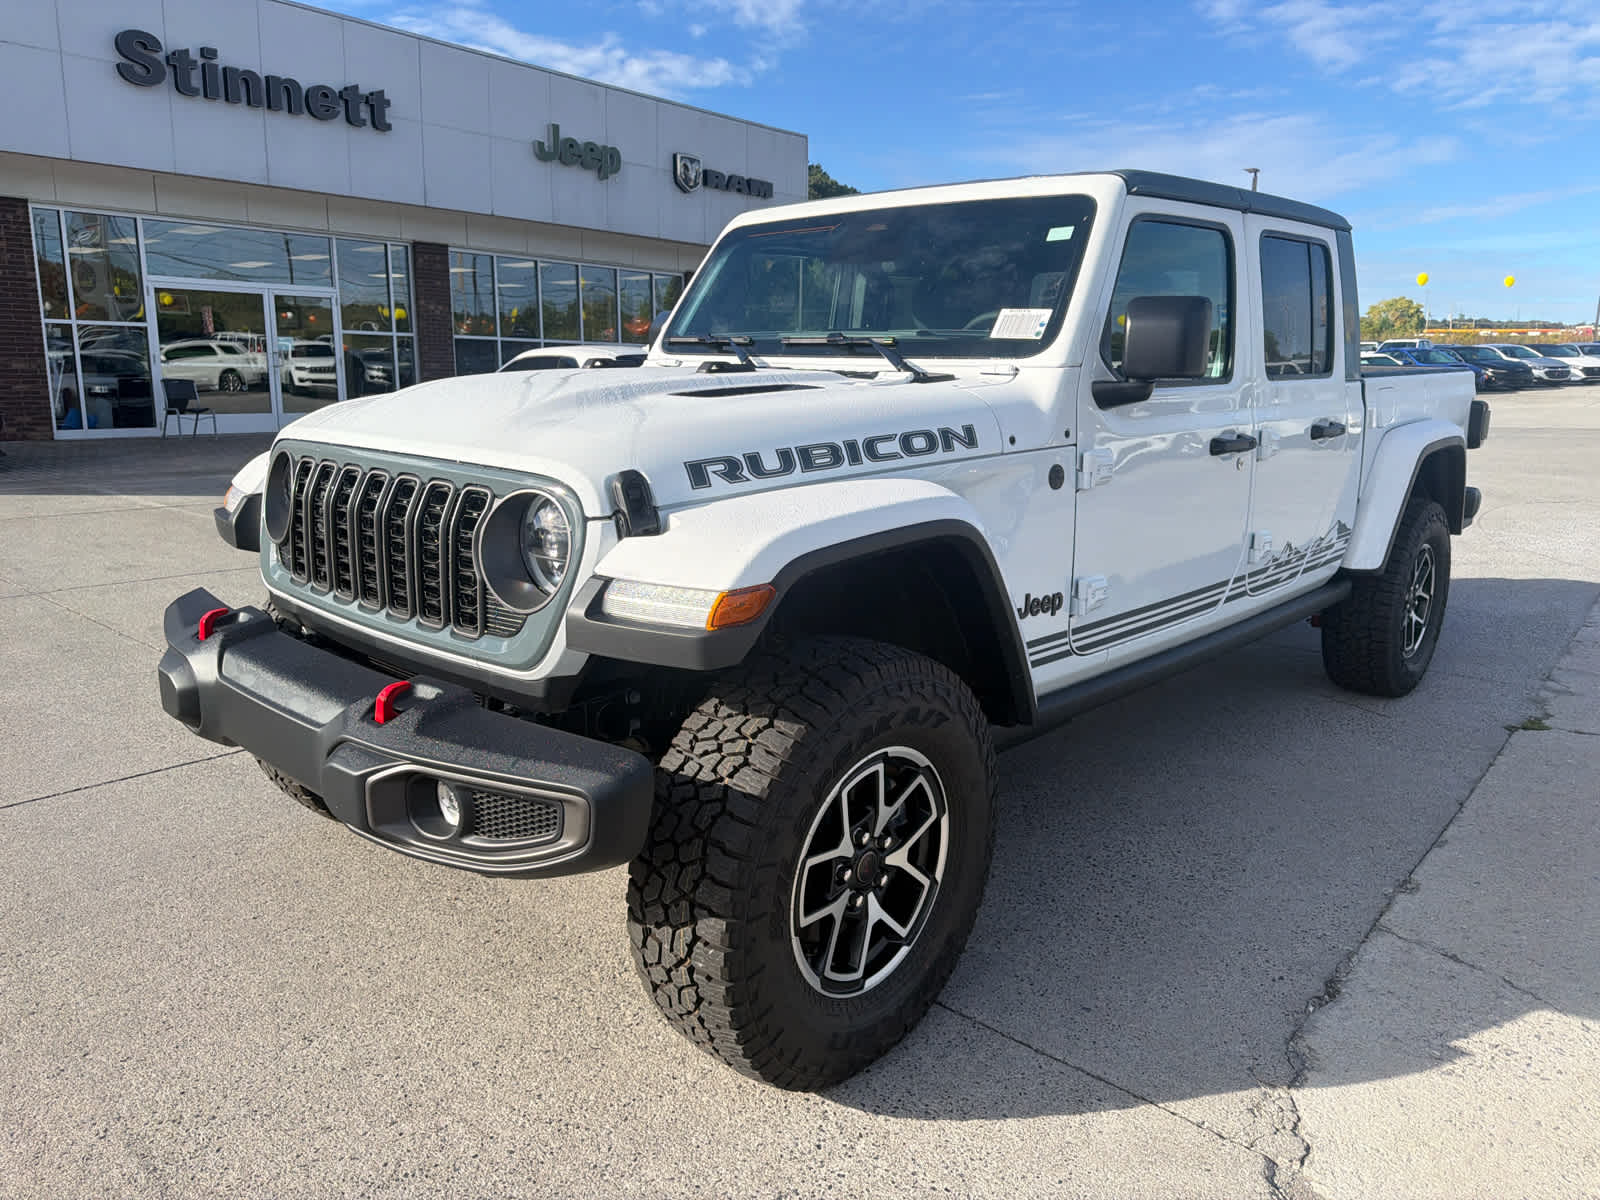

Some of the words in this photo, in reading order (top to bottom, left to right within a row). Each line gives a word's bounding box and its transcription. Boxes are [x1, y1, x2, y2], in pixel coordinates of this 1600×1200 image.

[115, 29, 392, 132] Stinnett
[532, 123, 622, 181] Jeep
[703, 168, 774, 199] RAM
[683, 424, 978, 490] RUBICON
[1017, 592, 1064, 620] Jeep
